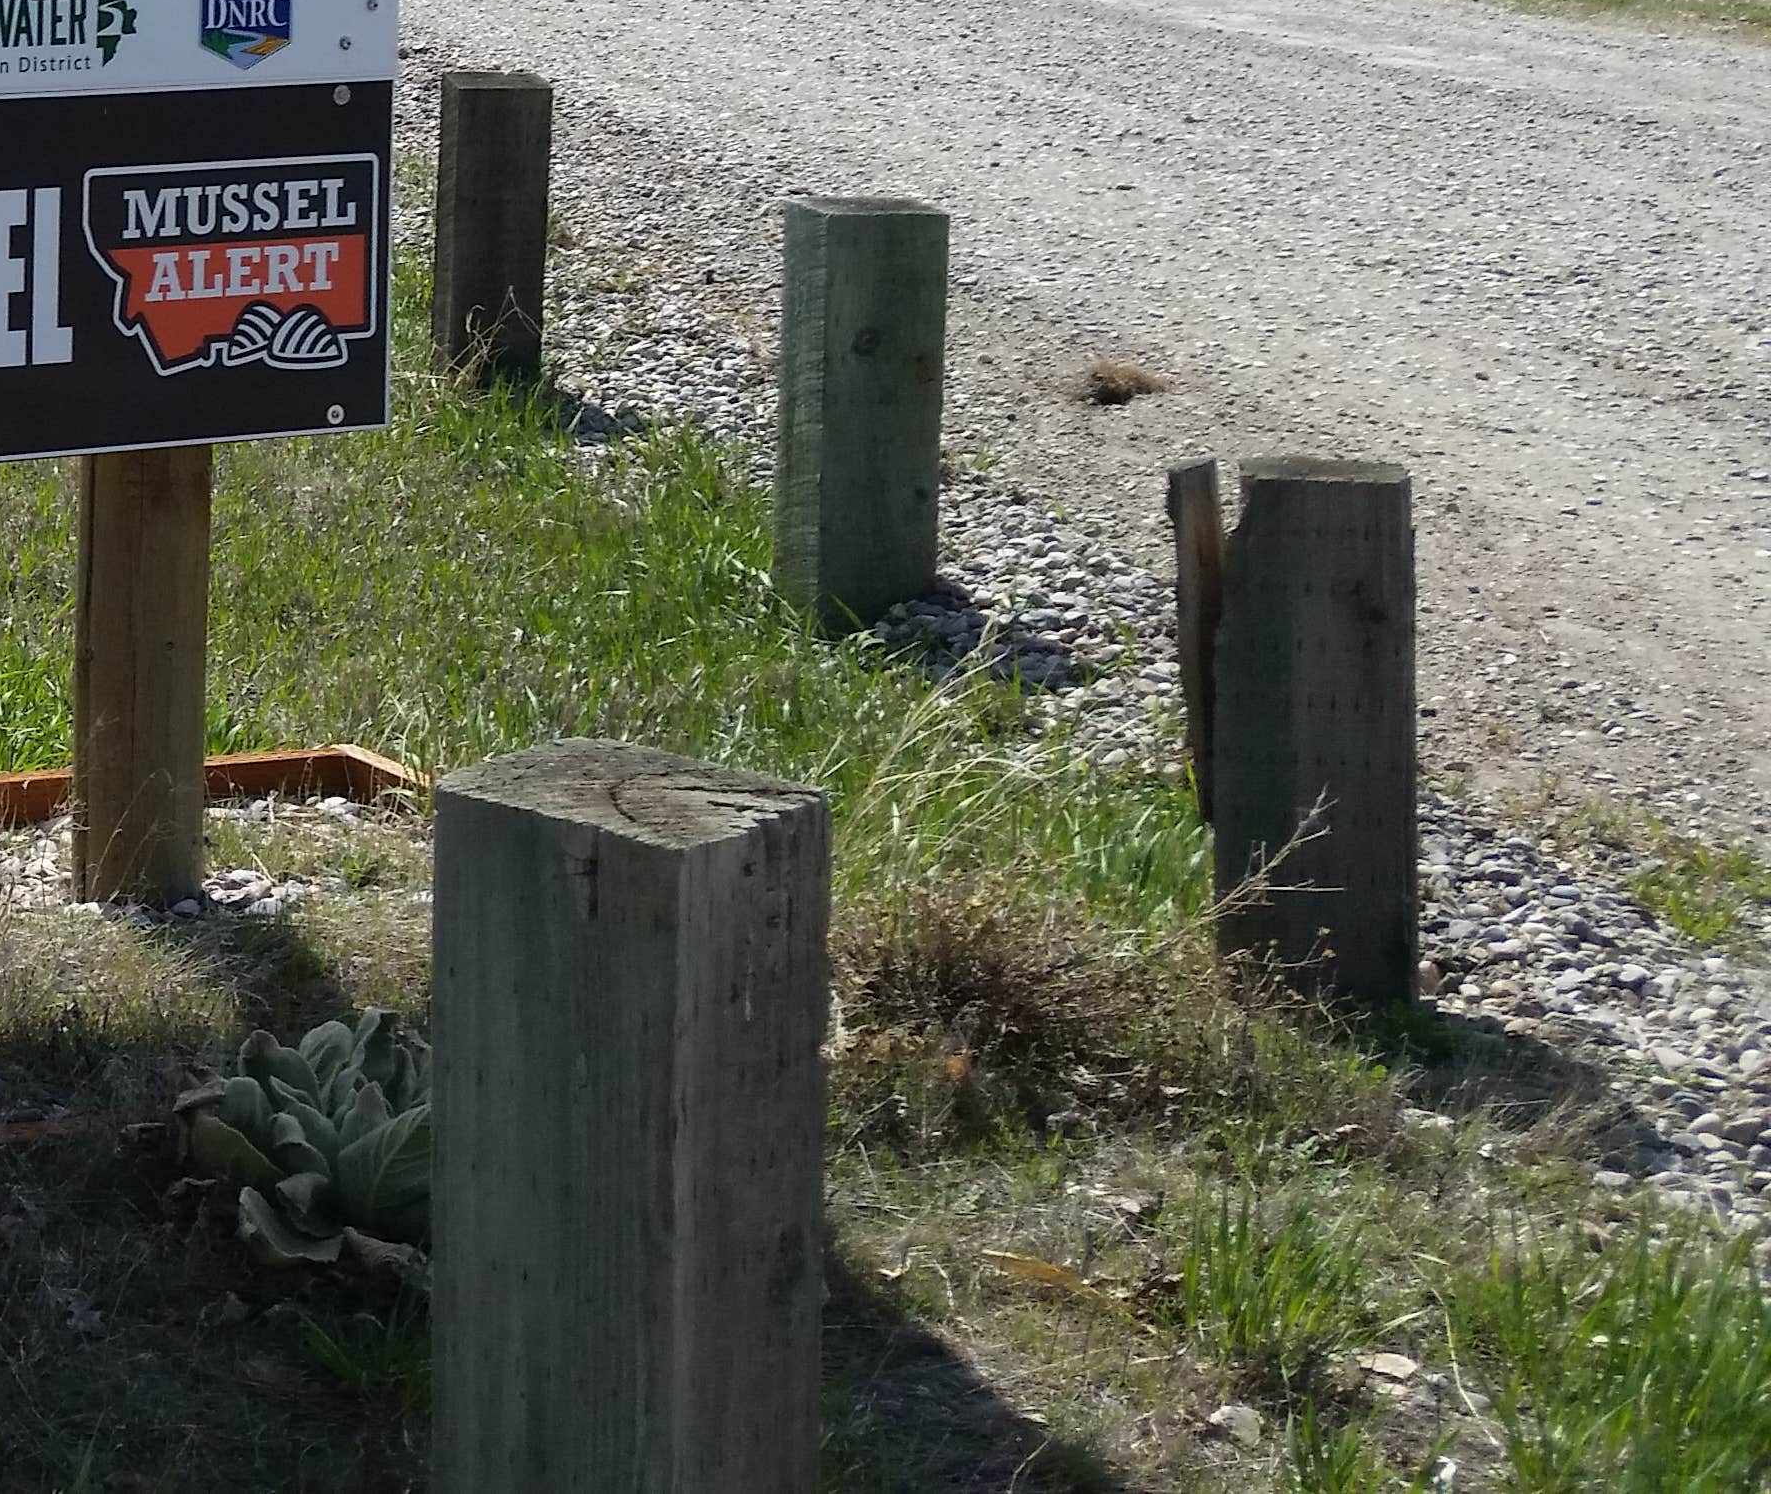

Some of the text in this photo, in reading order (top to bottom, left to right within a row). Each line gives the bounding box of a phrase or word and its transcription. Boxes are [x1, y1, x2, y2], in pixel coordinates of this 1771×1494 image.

[18, 54, 92, 74] District
[121, 177, 357, 241] MUSSEL
[143, 241, 341, 303] ALERT
